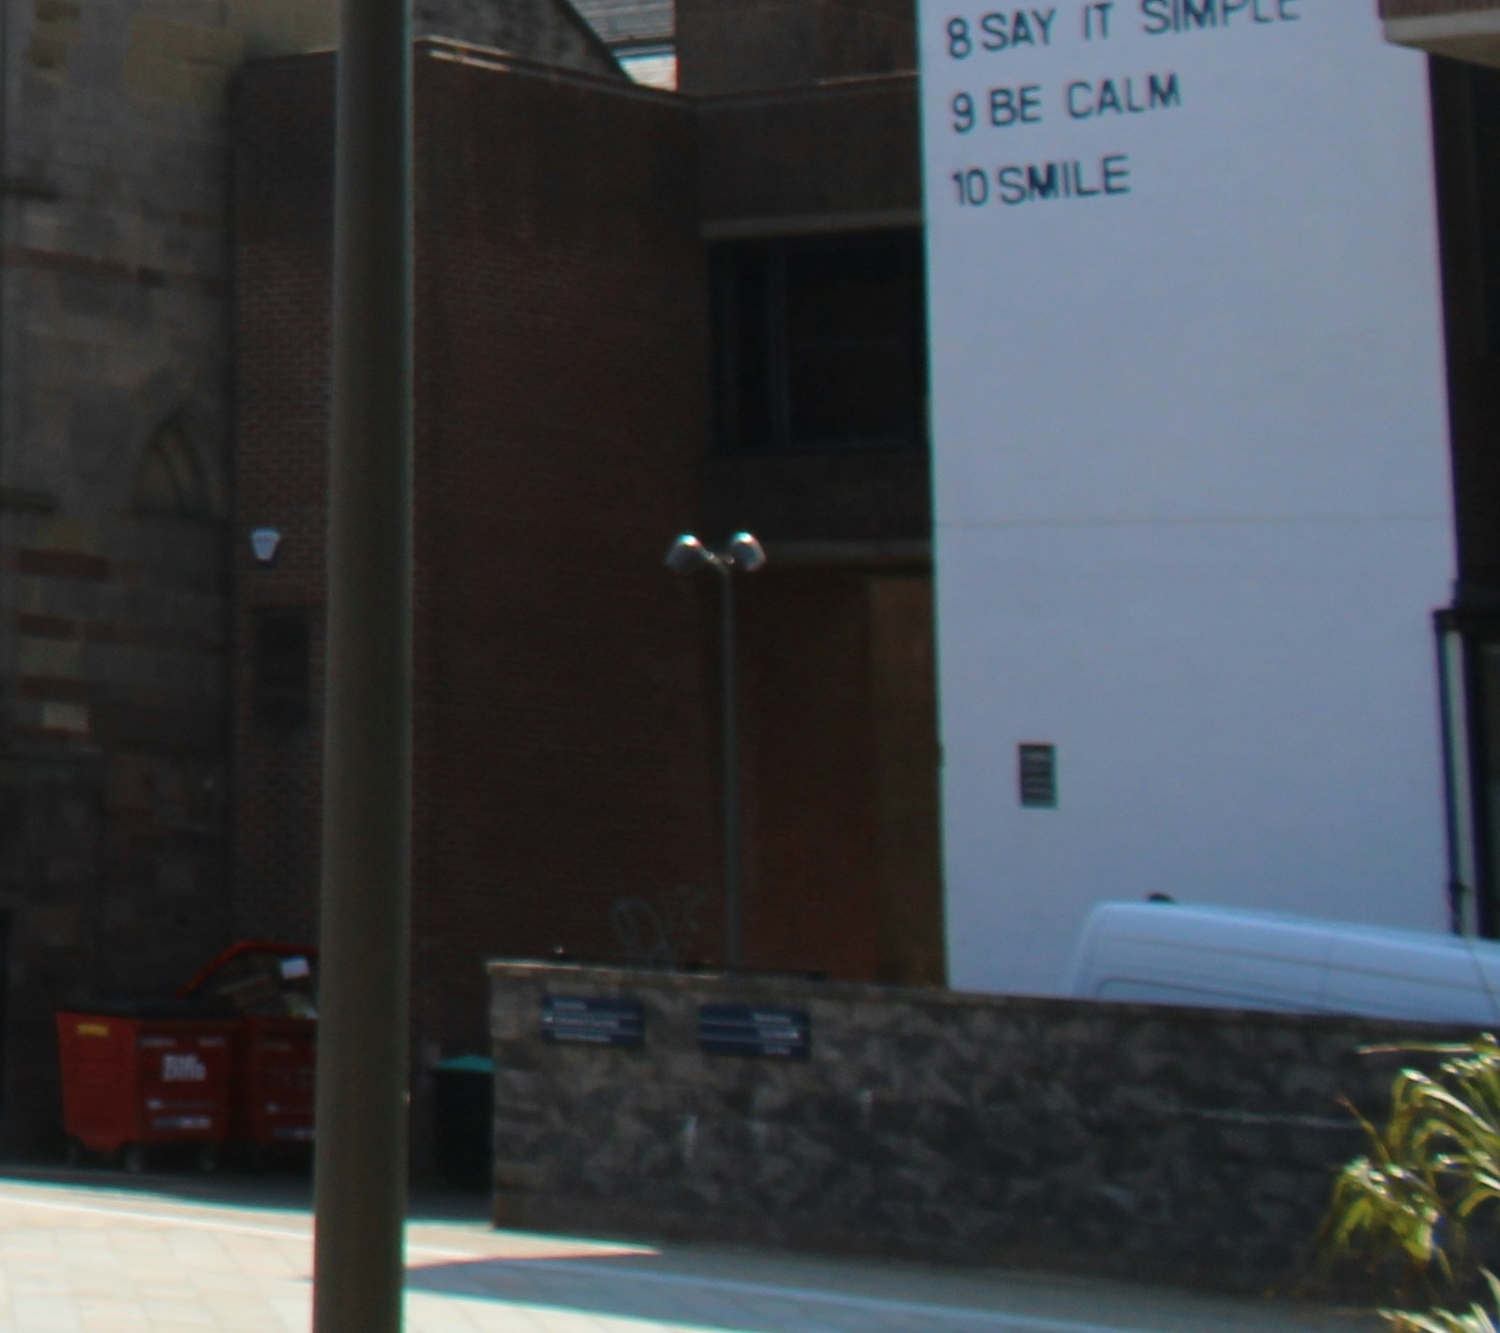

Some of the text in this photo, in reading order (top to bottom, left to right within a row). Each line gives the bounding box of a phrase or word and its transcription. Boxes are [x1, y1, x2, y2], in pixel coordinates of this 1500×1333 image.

[947, 17, 974, 60] 8
[981, 8, 1056, 52] SAY
[1084, 2, 1115, 40] IT
[953, 74, 1181, 135] 9 BE CALM
[953, 155, 1131, 207] 10 SMILE
